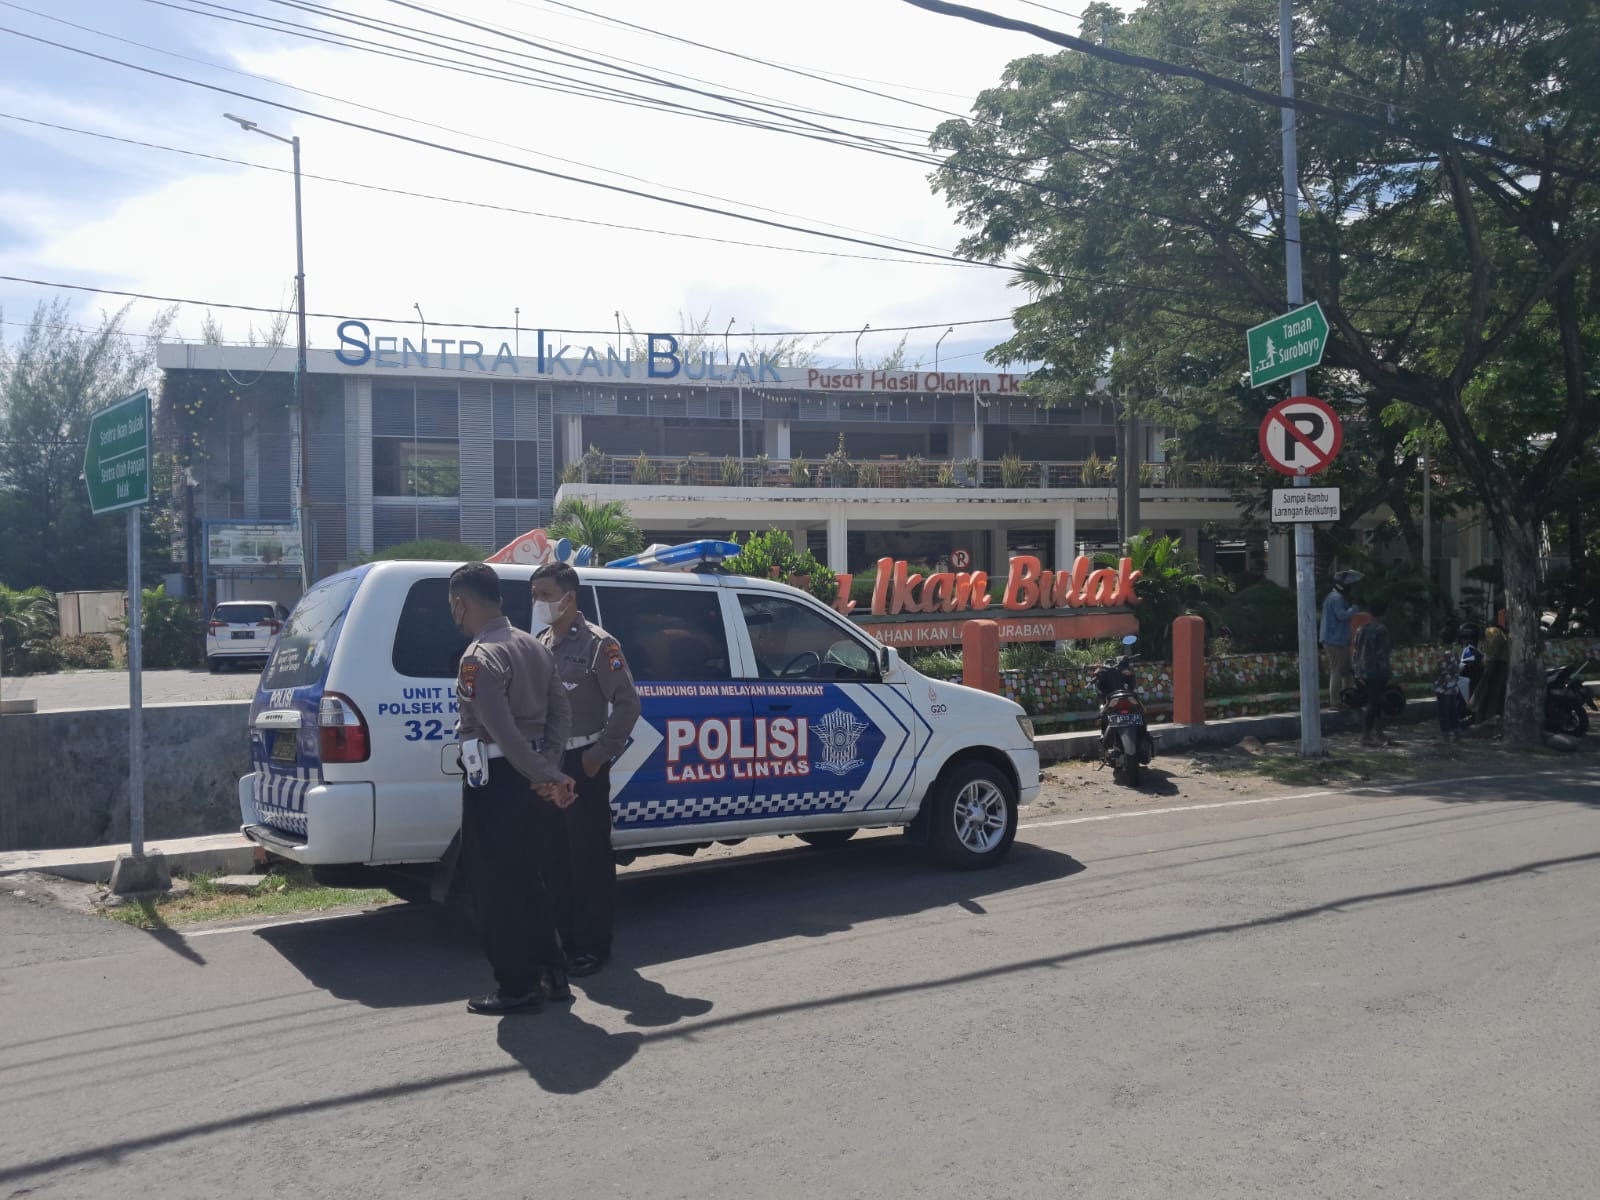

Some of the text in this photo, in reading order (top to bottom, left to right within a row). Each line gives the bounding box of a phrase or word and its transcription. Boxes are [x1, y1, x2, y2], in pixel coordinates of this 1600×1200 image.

[1282, 317, 1312, 340] Taman
[335, 320, 781, 382] SENTRA IKAN BULAK
[1279, 337, 1319, 363] Suroboyo
[808, 369, 864, 390] Pusat
[871, 371, 918, 391] Hasil
[924, 372, 990, 393] Olahan
[1283, 492, 1329, 505] Sampai Rambu
[1274, 505, 1338, 519] Larangan Berikutnya
[871, 557, 992, 615] Ikan
[1002, 555, 1142, 610] Bulak
[917, 627, 948, 641] IKAN
[403, 688, 442, 700] UNIT
[636, 686, 824, 696] MELINDUNGI DAN MELAYANI MASYARAKAT
[378, 702, 443, 715] POLSEK
[931, 703, 947, 713] G20
[404, 719, 459, 741] 32-
[667, 717, 808, 762] POLISI
[666, 763, 726, 782] LALU
[733, 760, 810, 778] LINTAS
